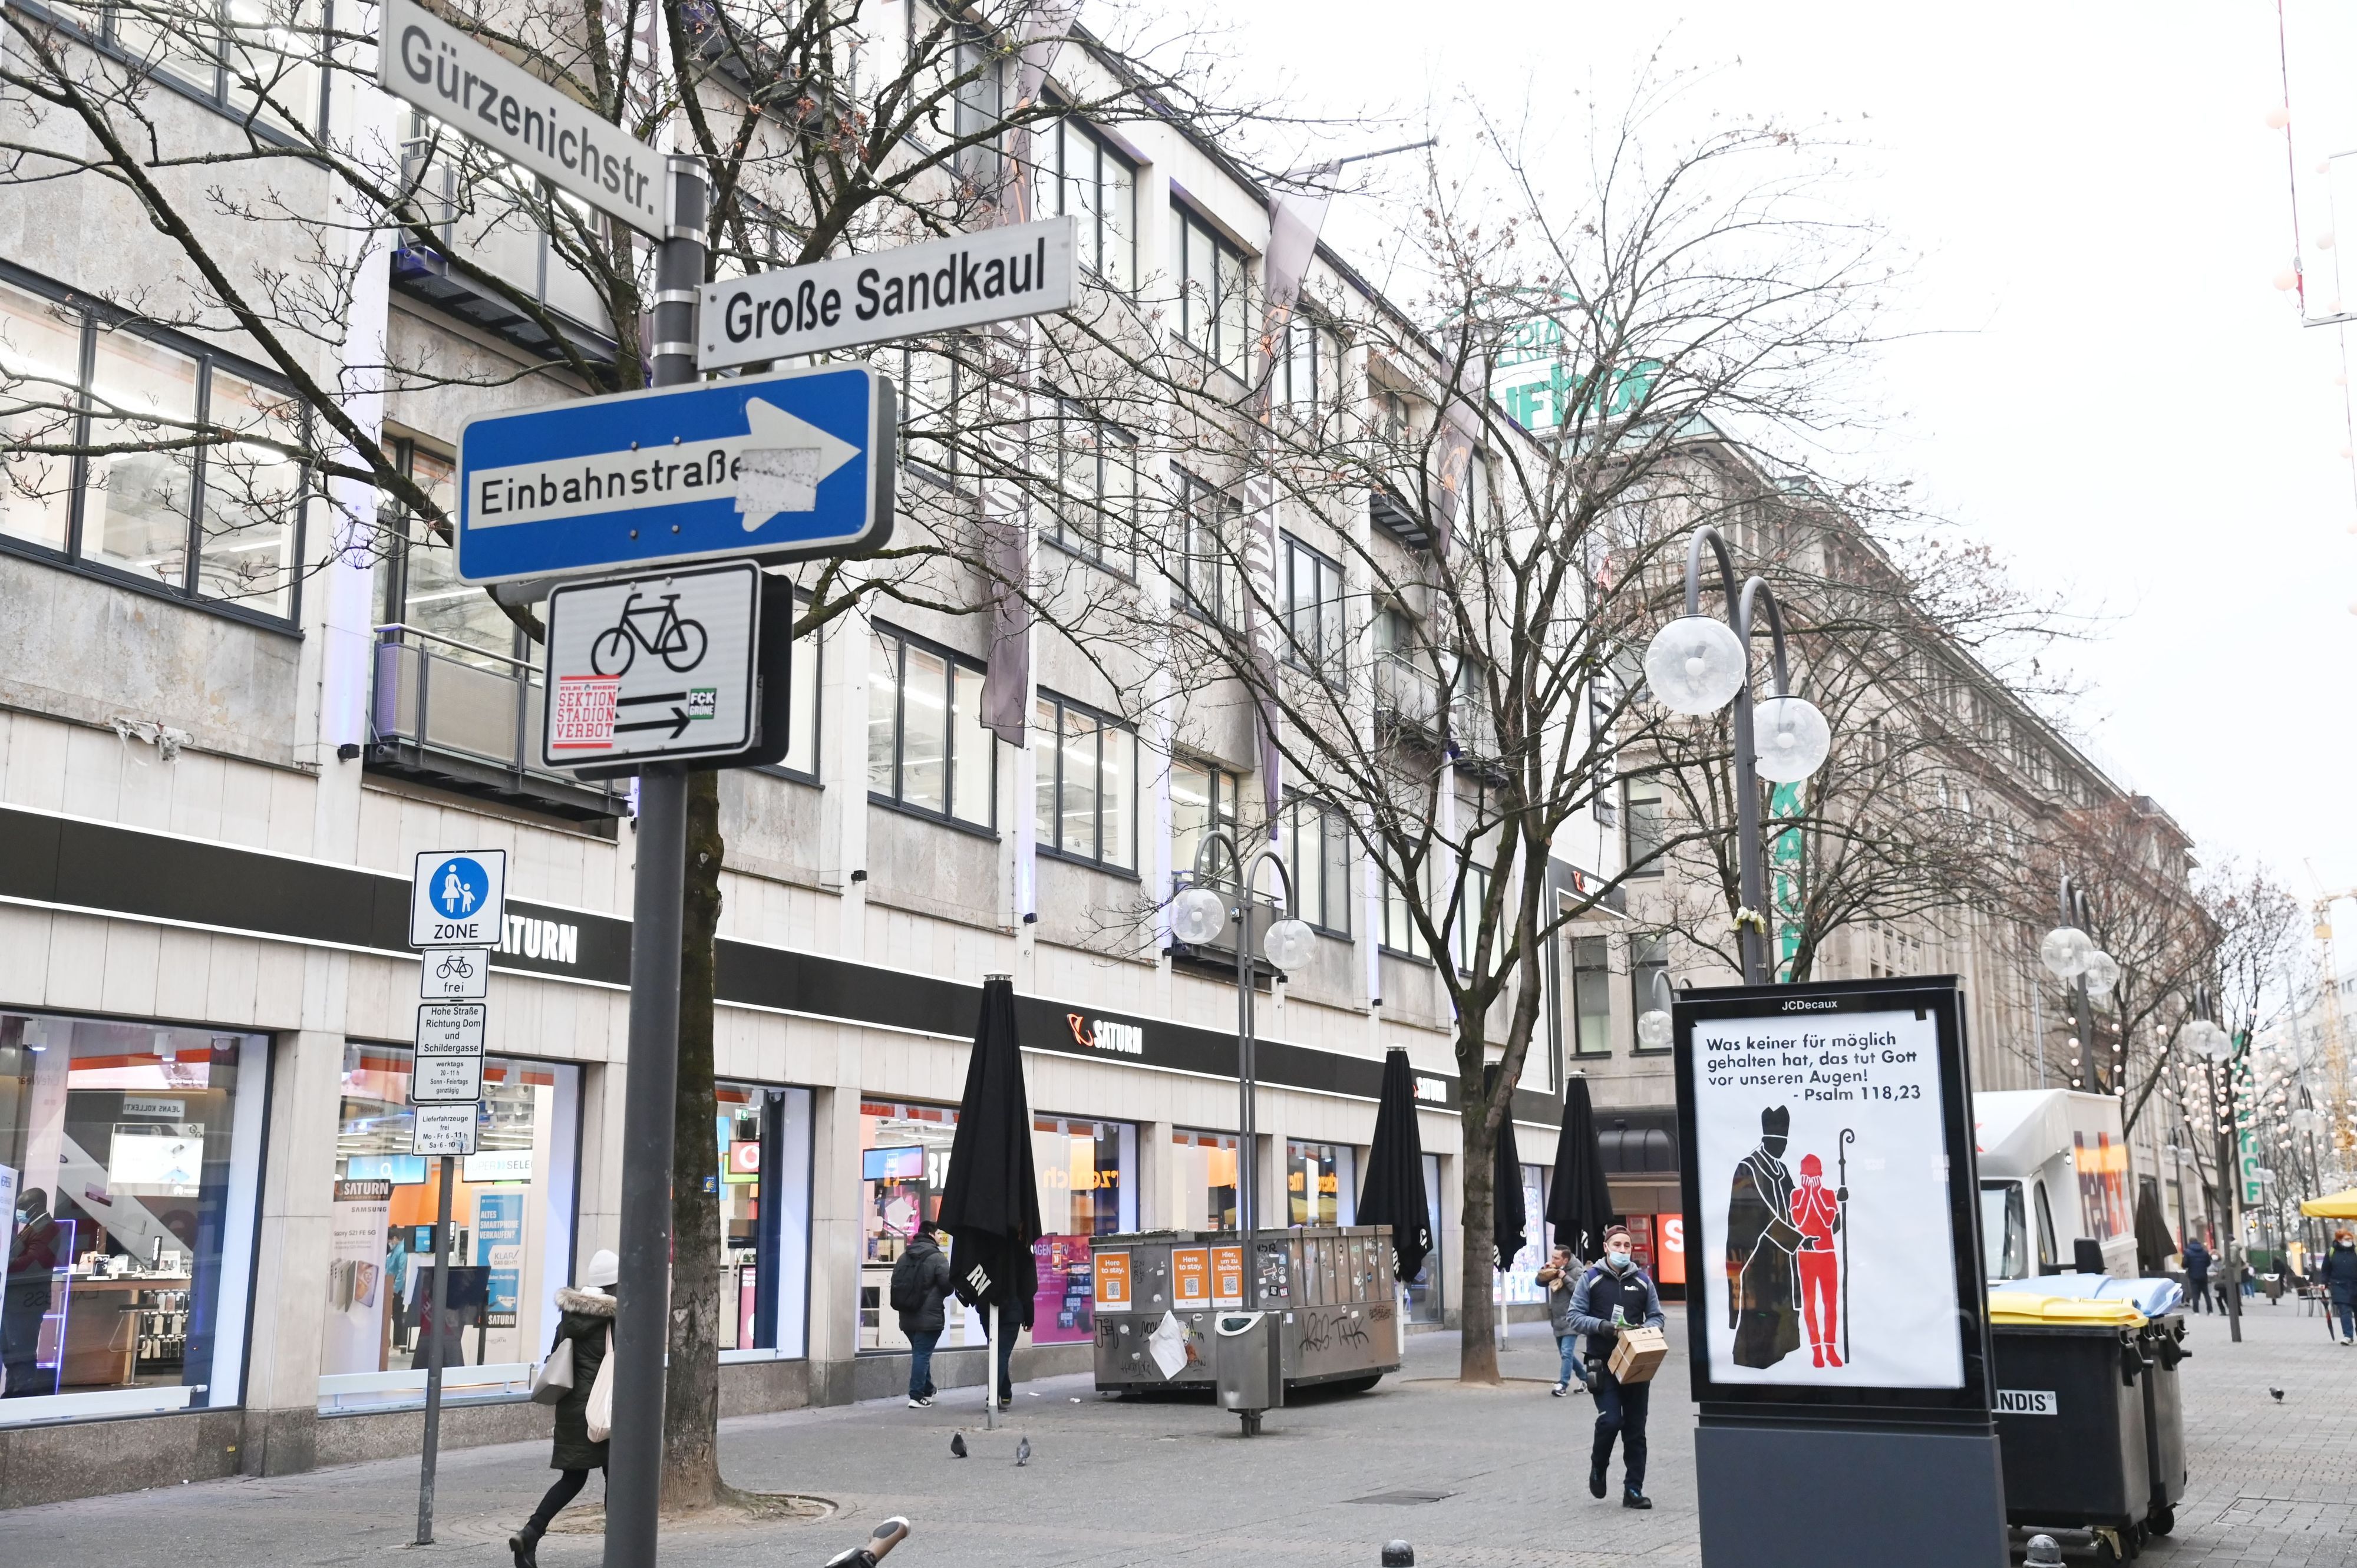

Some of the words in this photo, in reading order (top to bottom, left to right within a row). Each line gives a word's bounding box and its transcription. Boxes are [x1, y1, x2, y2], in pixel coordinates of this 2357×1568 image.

[400, 25, 655, 216] Gürzenichstr.
[725, 276, 842, 345] Große
[855, 237, 1045, 321] Sandkaul
[480, 449, 741, 517] Einbahnstraße
[559, 692, 616, 707] SEKTION
[691, 692, 715, 704] FCK
[557, 707, 615, 722] STADION
[689, 704, 714, 716] GRÜNE
[556, 722, 613, 738] VERBOT
[434, 923, 479, 939] ZONE
[444, 982, 464, 993] frei
[431, 1007, 451, 1015] Hohe
[453, 1007, 478, 1015] Straße
[1781, 1000, 1838, 1011] JCDecaux
[426, 1019, 461, 1029] Richtung
[463, 1019, 481, 1027] Dom
[445, 1031, 460, 1039] und
[1094, 1019, 1143, 1055] SATURN
[1706, 1038, 1741, 1051] Was
[1746, 1034, 1797, 1050] keiner
[1803, 1033, 1825, 1049] für
[1831, 1031, 1896, 1051] möglich
[424, 1044, 478, 1054] Schildergasse
[1708, 1052, 1776, 1074] gehalten
[1782, 1052, 1813, 1068] hat,
[1819, 1050, 1849, 1066] das
[1853, 1051, 1876, 1064] tut
[1881, 1049, 1917, 1064] Gott
[1708, 1073, 1734, 1086] vor
[1739, 1071, 1803, 1085] unseren
[1808, 1068, 1869, 1088] Augen!
[1416, 1077, 1447, 1103] SATURN
[1804, 1087, 1853, 1102] Psalm
[1861, 1085, 1922, 1102] 118,23
[344, 1182, 389, 1195] SATURN
[481, 1210, 497, 1219] ALTES
[480, 1220, 519, 1230] SMARTPHONE
[480, 1231, 515, 1239] VERKAUFEN?
[488, 1315, 516, 1325] SATURN
